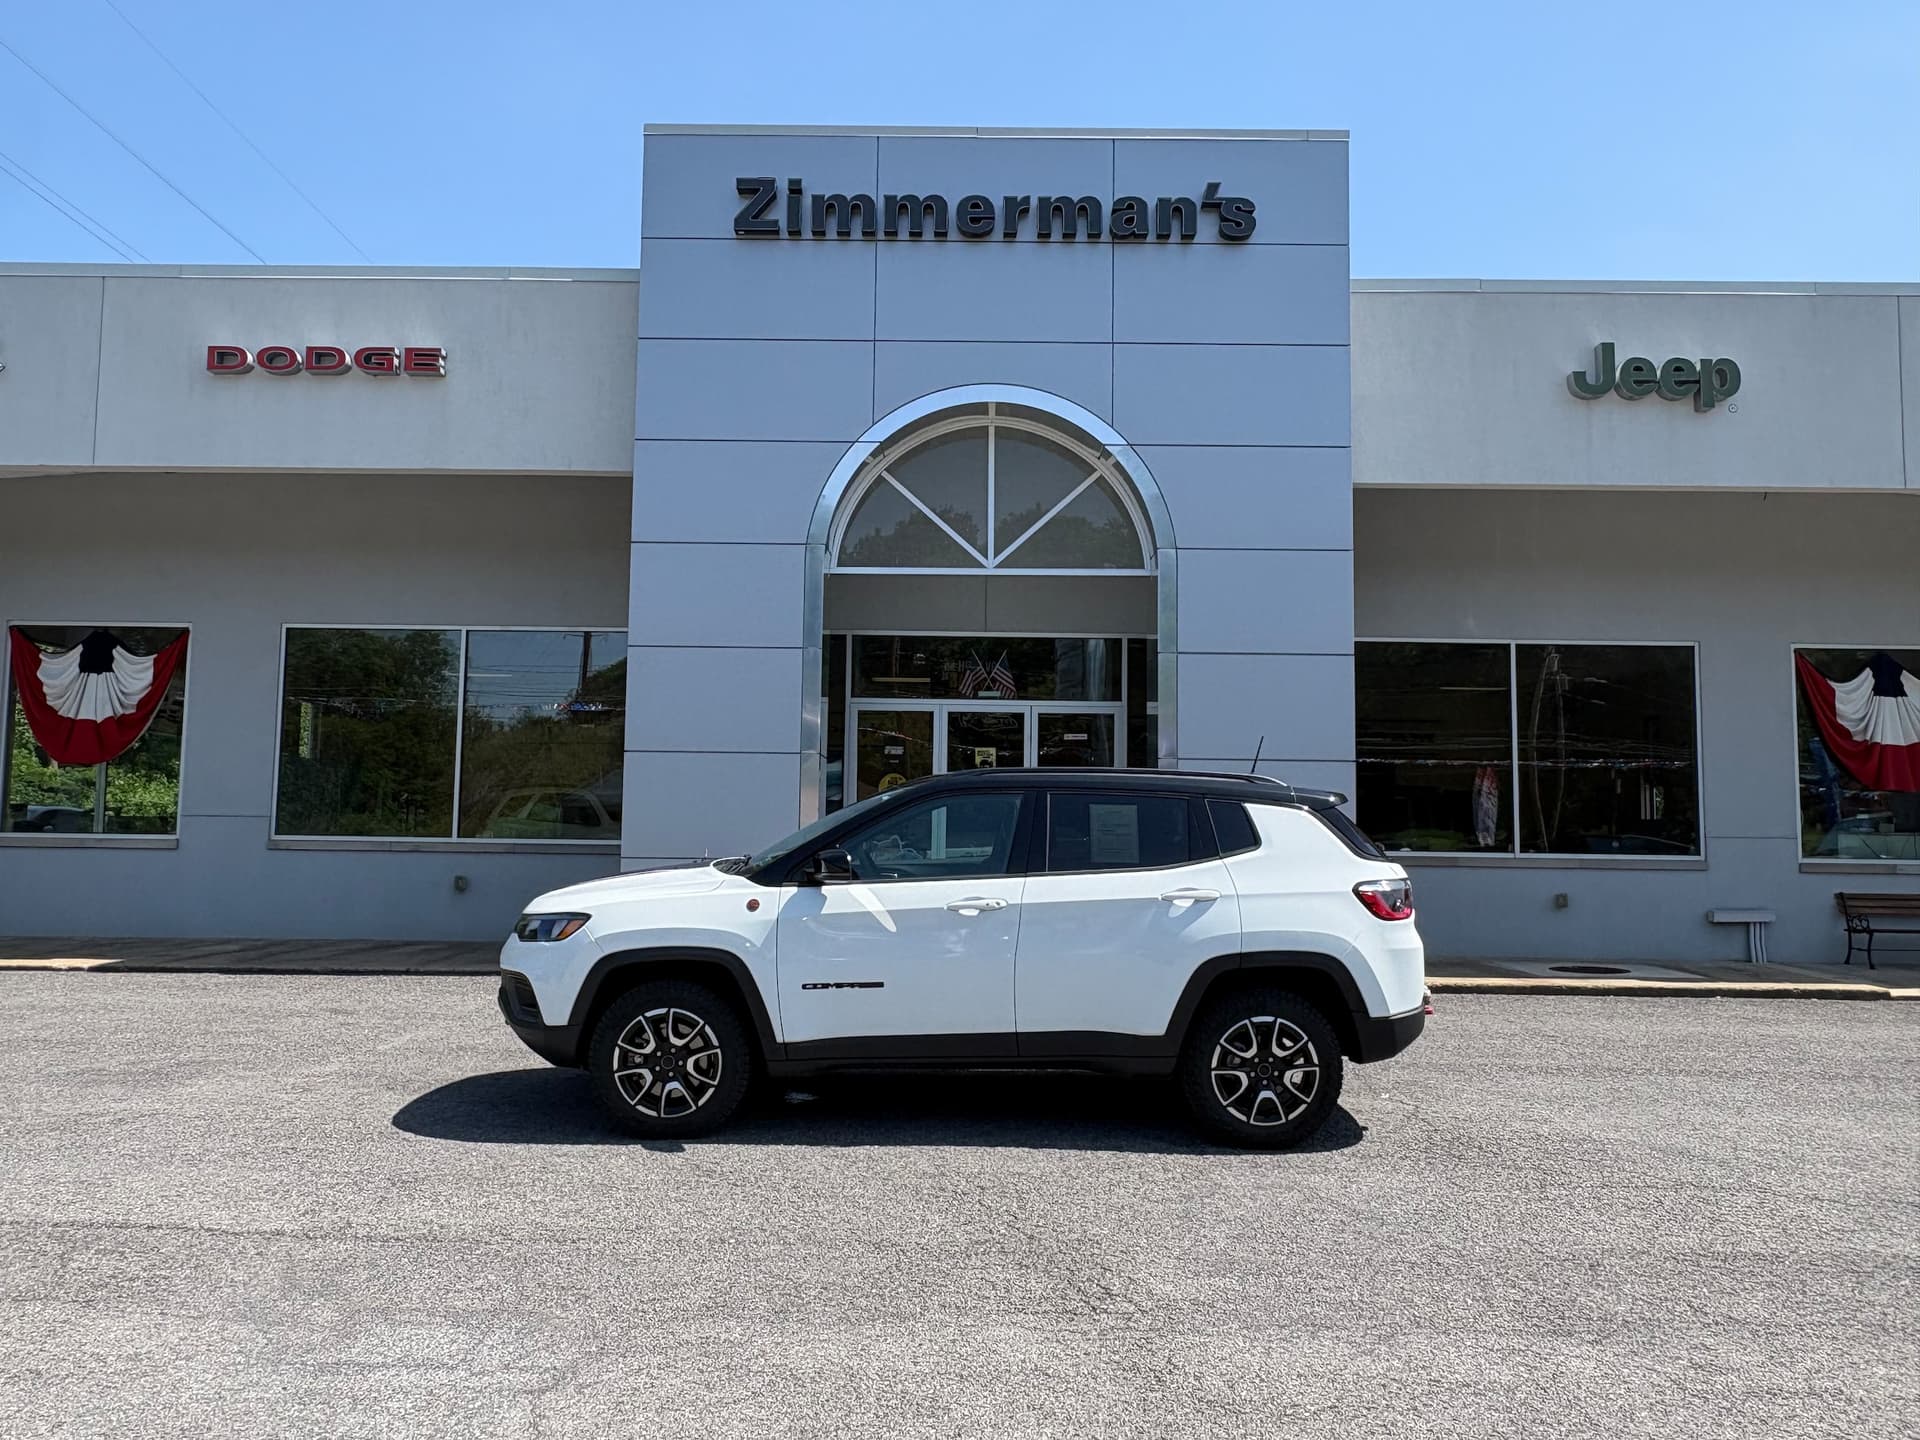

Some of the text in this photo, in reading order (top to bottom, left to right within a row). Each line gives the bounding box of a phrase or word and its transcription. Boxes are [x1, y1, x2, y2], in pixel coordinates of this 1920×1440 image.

[733, 177, 1257, 242] Zimmerman's
[206, 345, 447, 377] DODGE
[1567, 342, 1741, 412] Jeep
